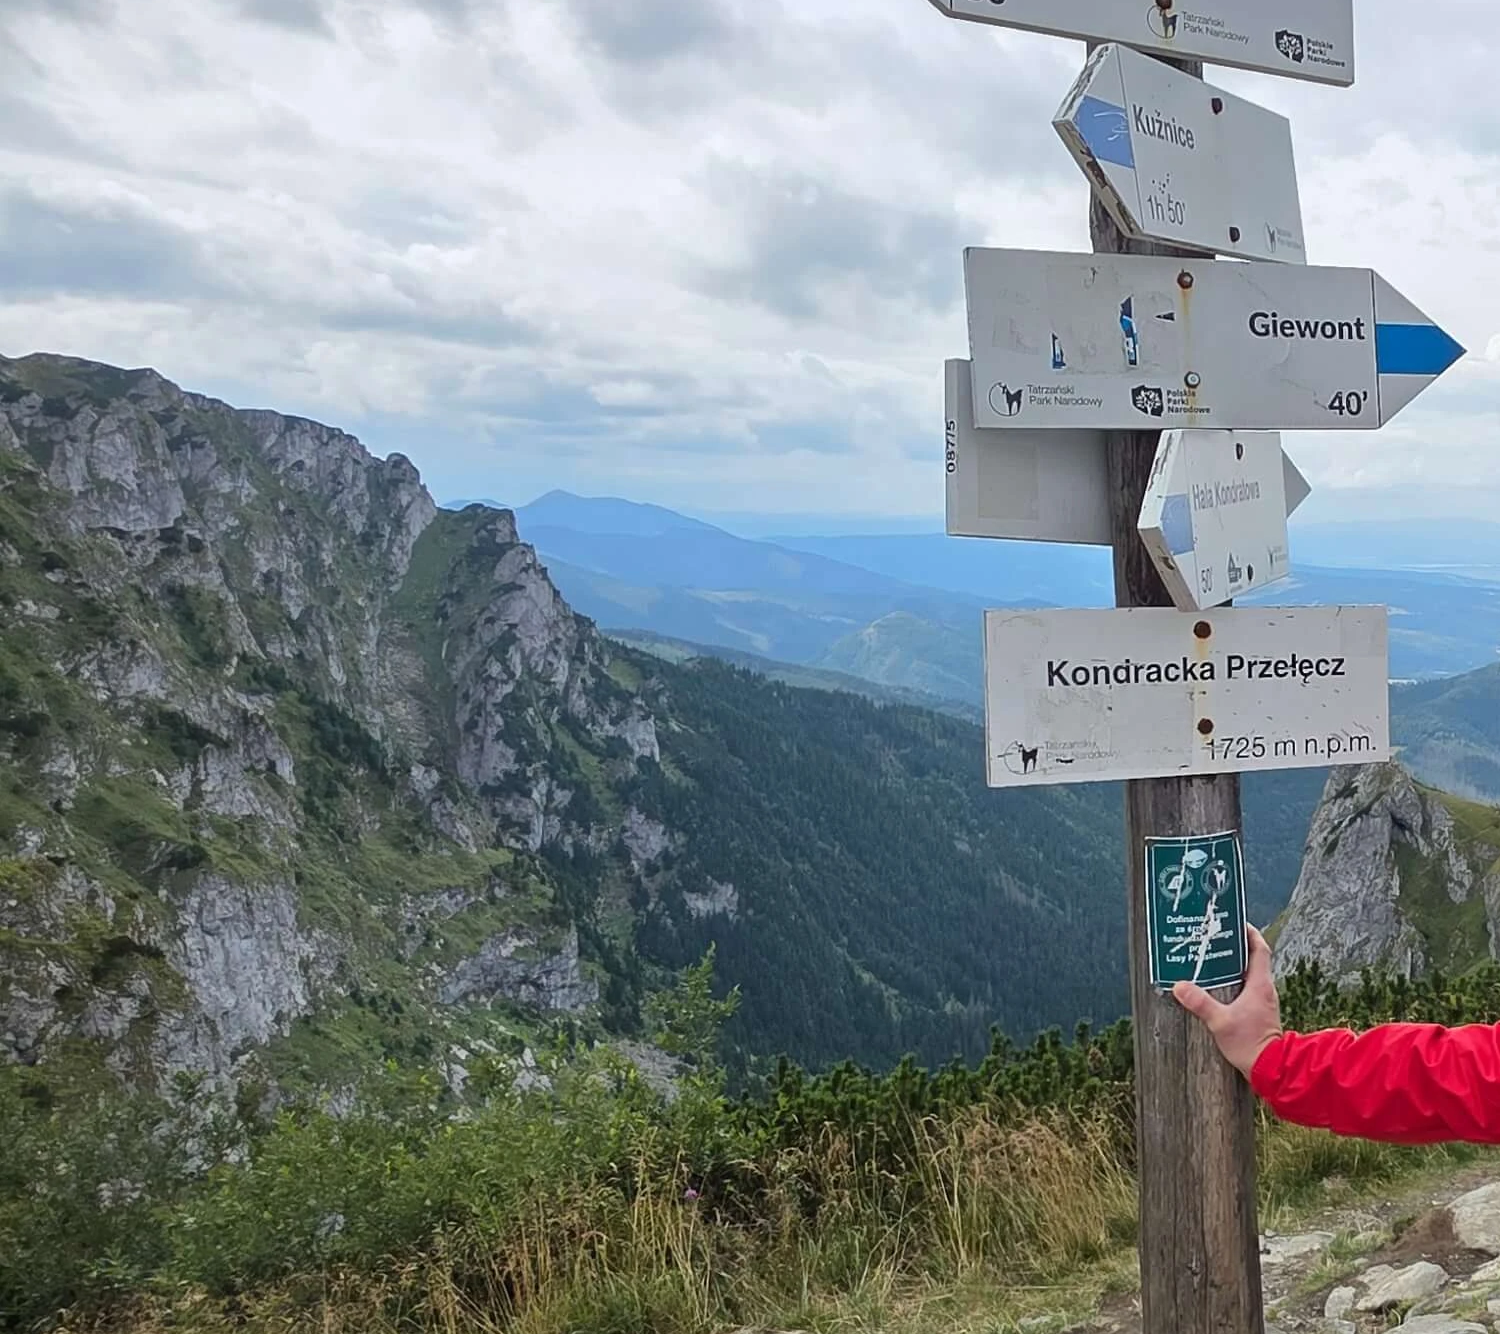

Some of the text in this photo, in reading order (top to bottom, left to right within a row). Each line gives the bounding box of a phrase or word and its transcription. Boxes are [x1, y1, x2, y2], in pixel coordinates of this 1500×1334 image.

[1183, 21, 1250, 45] Park Narodowy
[1307, 38, 1334, 50] Polskie
[1307, 46, 1327, 56] Parki
[1307, 54, 1345, 68] Narodowe
[1146, 194, 1165, 222] 1h
[1248, 310, 1366, 340] Giewont
[1026, 383, 1075, 395] Tatrzański
[1166, 388, 1196, 398] Polskie
[1029, 394, 1104, 408] Park Narodowy
[1167, 397, 1189, 406] Parki
[1167, 405, 1211, 414] Narodowe
[1047, 652, 1345, 687] Kondracka Przełęcz
[1206, 733, 1377, 761] 1725 m n.p.m.
